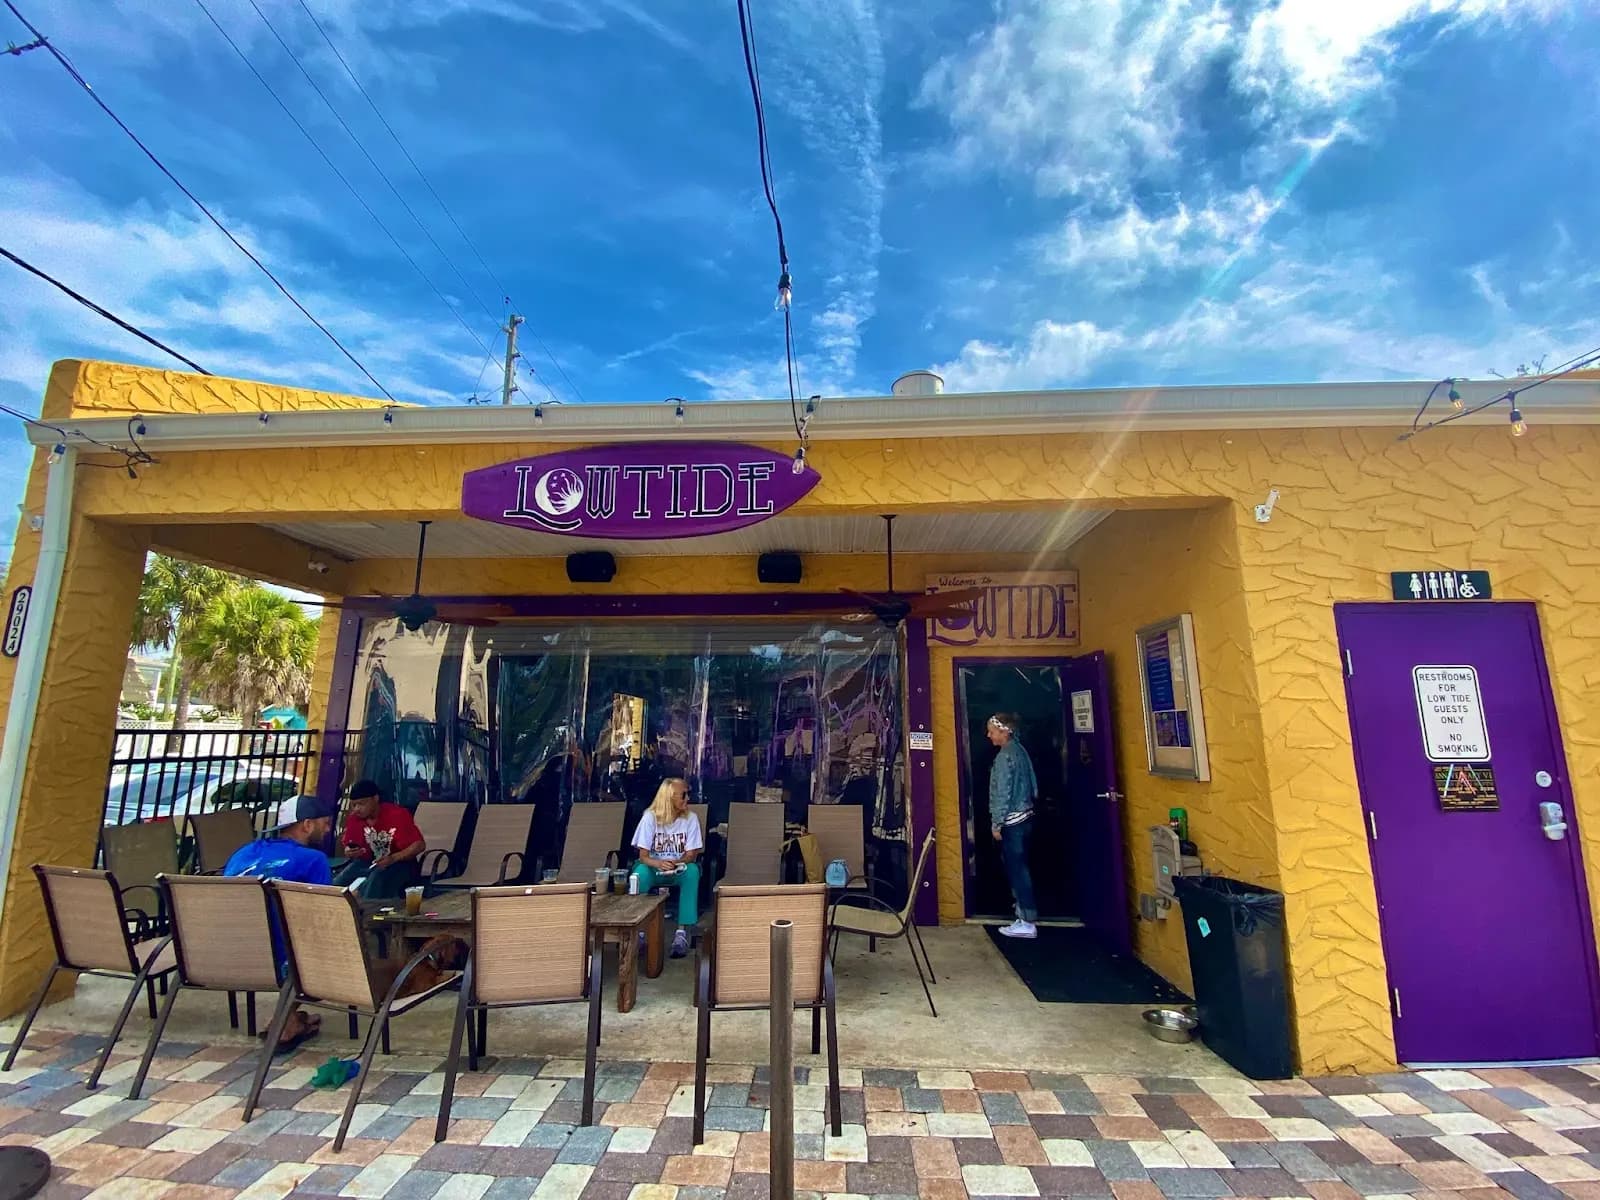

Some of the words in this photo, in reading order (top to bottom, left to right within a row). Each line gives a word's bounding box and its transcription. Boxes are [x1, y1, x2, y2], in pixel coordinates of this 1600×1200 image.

[938, 575, 977, 587] Welcome
[7, 591, 27, 652] 29024
[1418, 673, 1473, 682] RESTROOMS
[1438, 683, 1457, 692] FOR
[1426, 694, 1447, 703] LOW
[1450, 694, 1472, 703] TIDE
[1433, 705, 1470, 713] GUESTS
[1440, 716, 1465, 724] ONLY
[1449, 733, 1463, 741] NO
[1437, 744, 1479, 753] SMOKING
